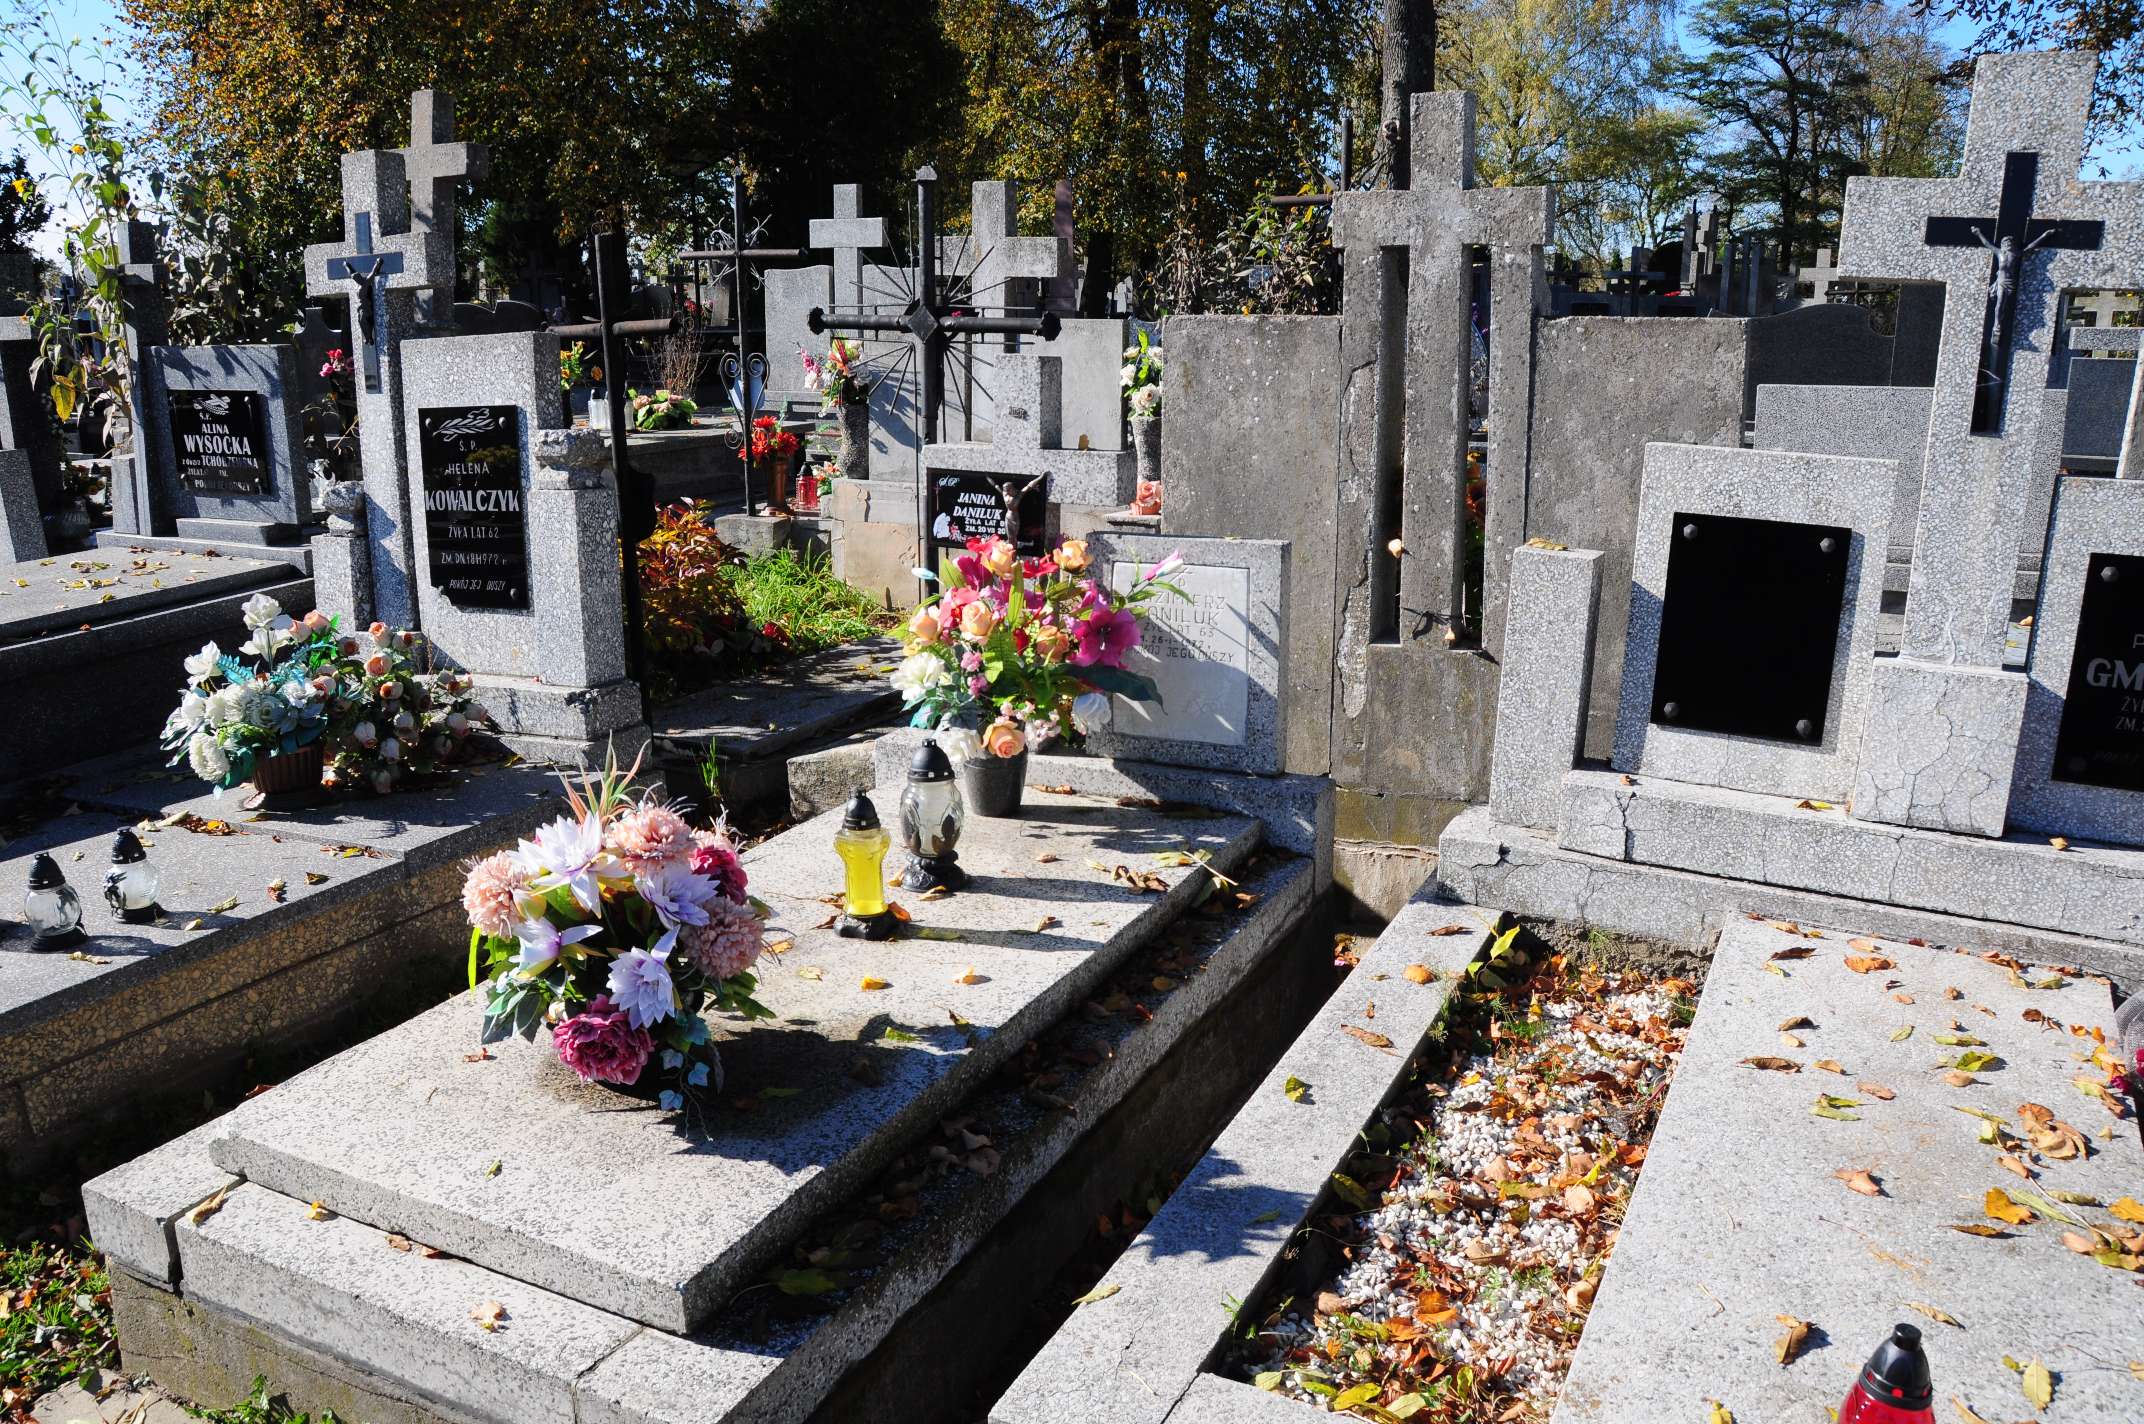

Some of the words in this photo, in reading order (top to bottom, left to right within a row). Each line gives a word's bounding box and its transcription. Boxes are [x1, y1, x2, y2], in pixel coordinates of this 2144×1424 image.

[201, 423, 229, 434] ALINA
[183, 434, 252, 455] WYSOCKA
[448, 461, 490, 475] HELENA
[425, 489, 520, 512] KOWALCZYK
[957, 492, 996, 506] JANINA
[953, 506, 1003, 520] DANILUK
[470, 526, 486, 539] LAT
[488, 527, 501, 539] 62
[1143, 591, 1225, 610] ZIMERZ
[1148, 604, 1220, 627] ANILUK
